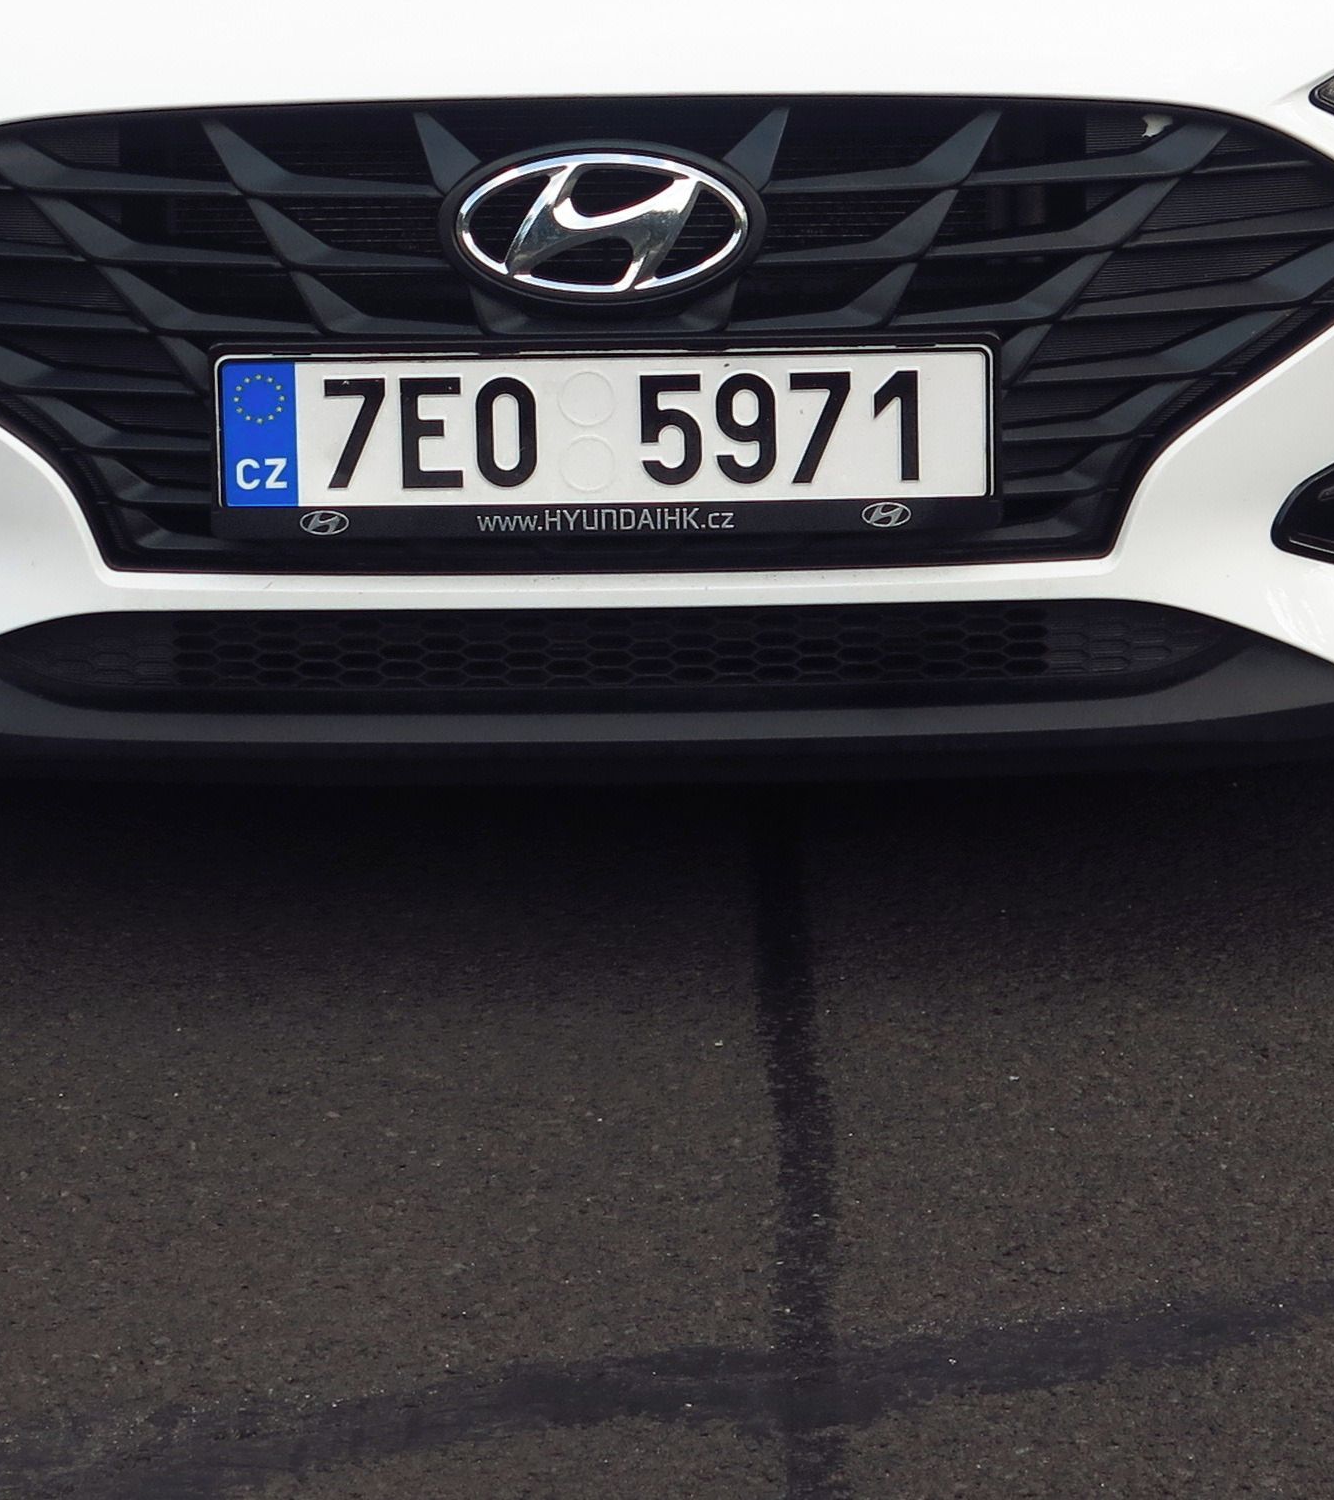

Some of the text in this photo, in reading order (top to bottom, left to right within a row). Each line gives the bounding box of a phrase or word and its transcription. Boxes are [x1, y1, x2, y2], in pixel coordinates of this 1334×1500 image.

[324, 370, 921, 489] 7E0 5971
[236, 457, 289, 491] CZ
[476, 508, 735, 532] www.HYUNDAIHK.cz
